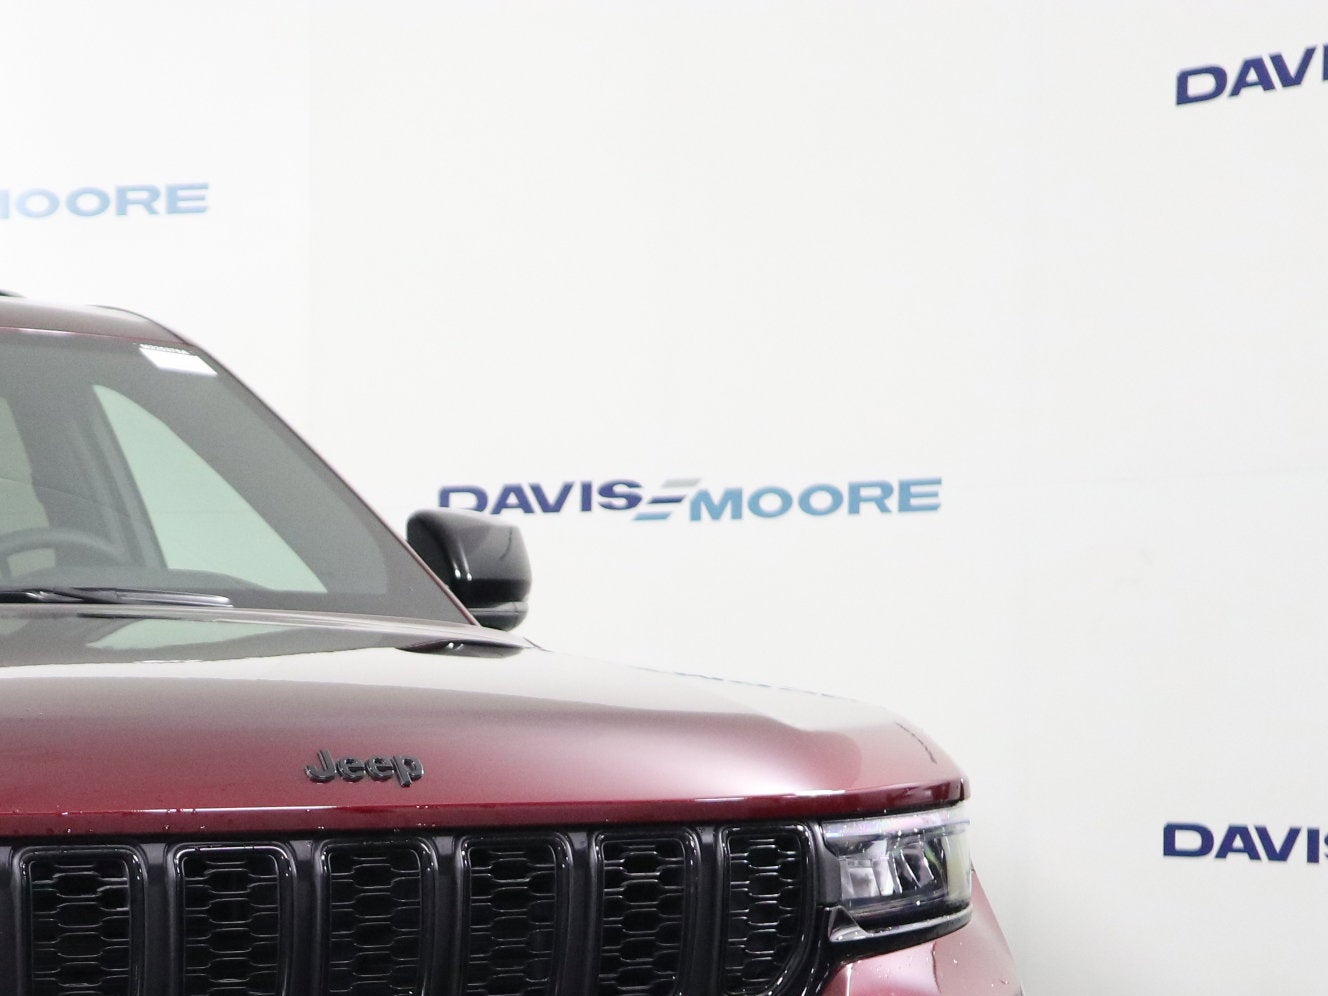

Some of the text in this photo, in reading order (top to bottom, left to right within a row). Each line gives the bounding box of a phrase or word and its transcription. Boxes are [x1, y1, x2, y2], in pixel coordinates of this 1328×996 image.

[438, 477, 943, 522] DAVIS MOORE
[304, 749, 424, 788] Jeep
[1163, 822, 1328, 864] DAVI
